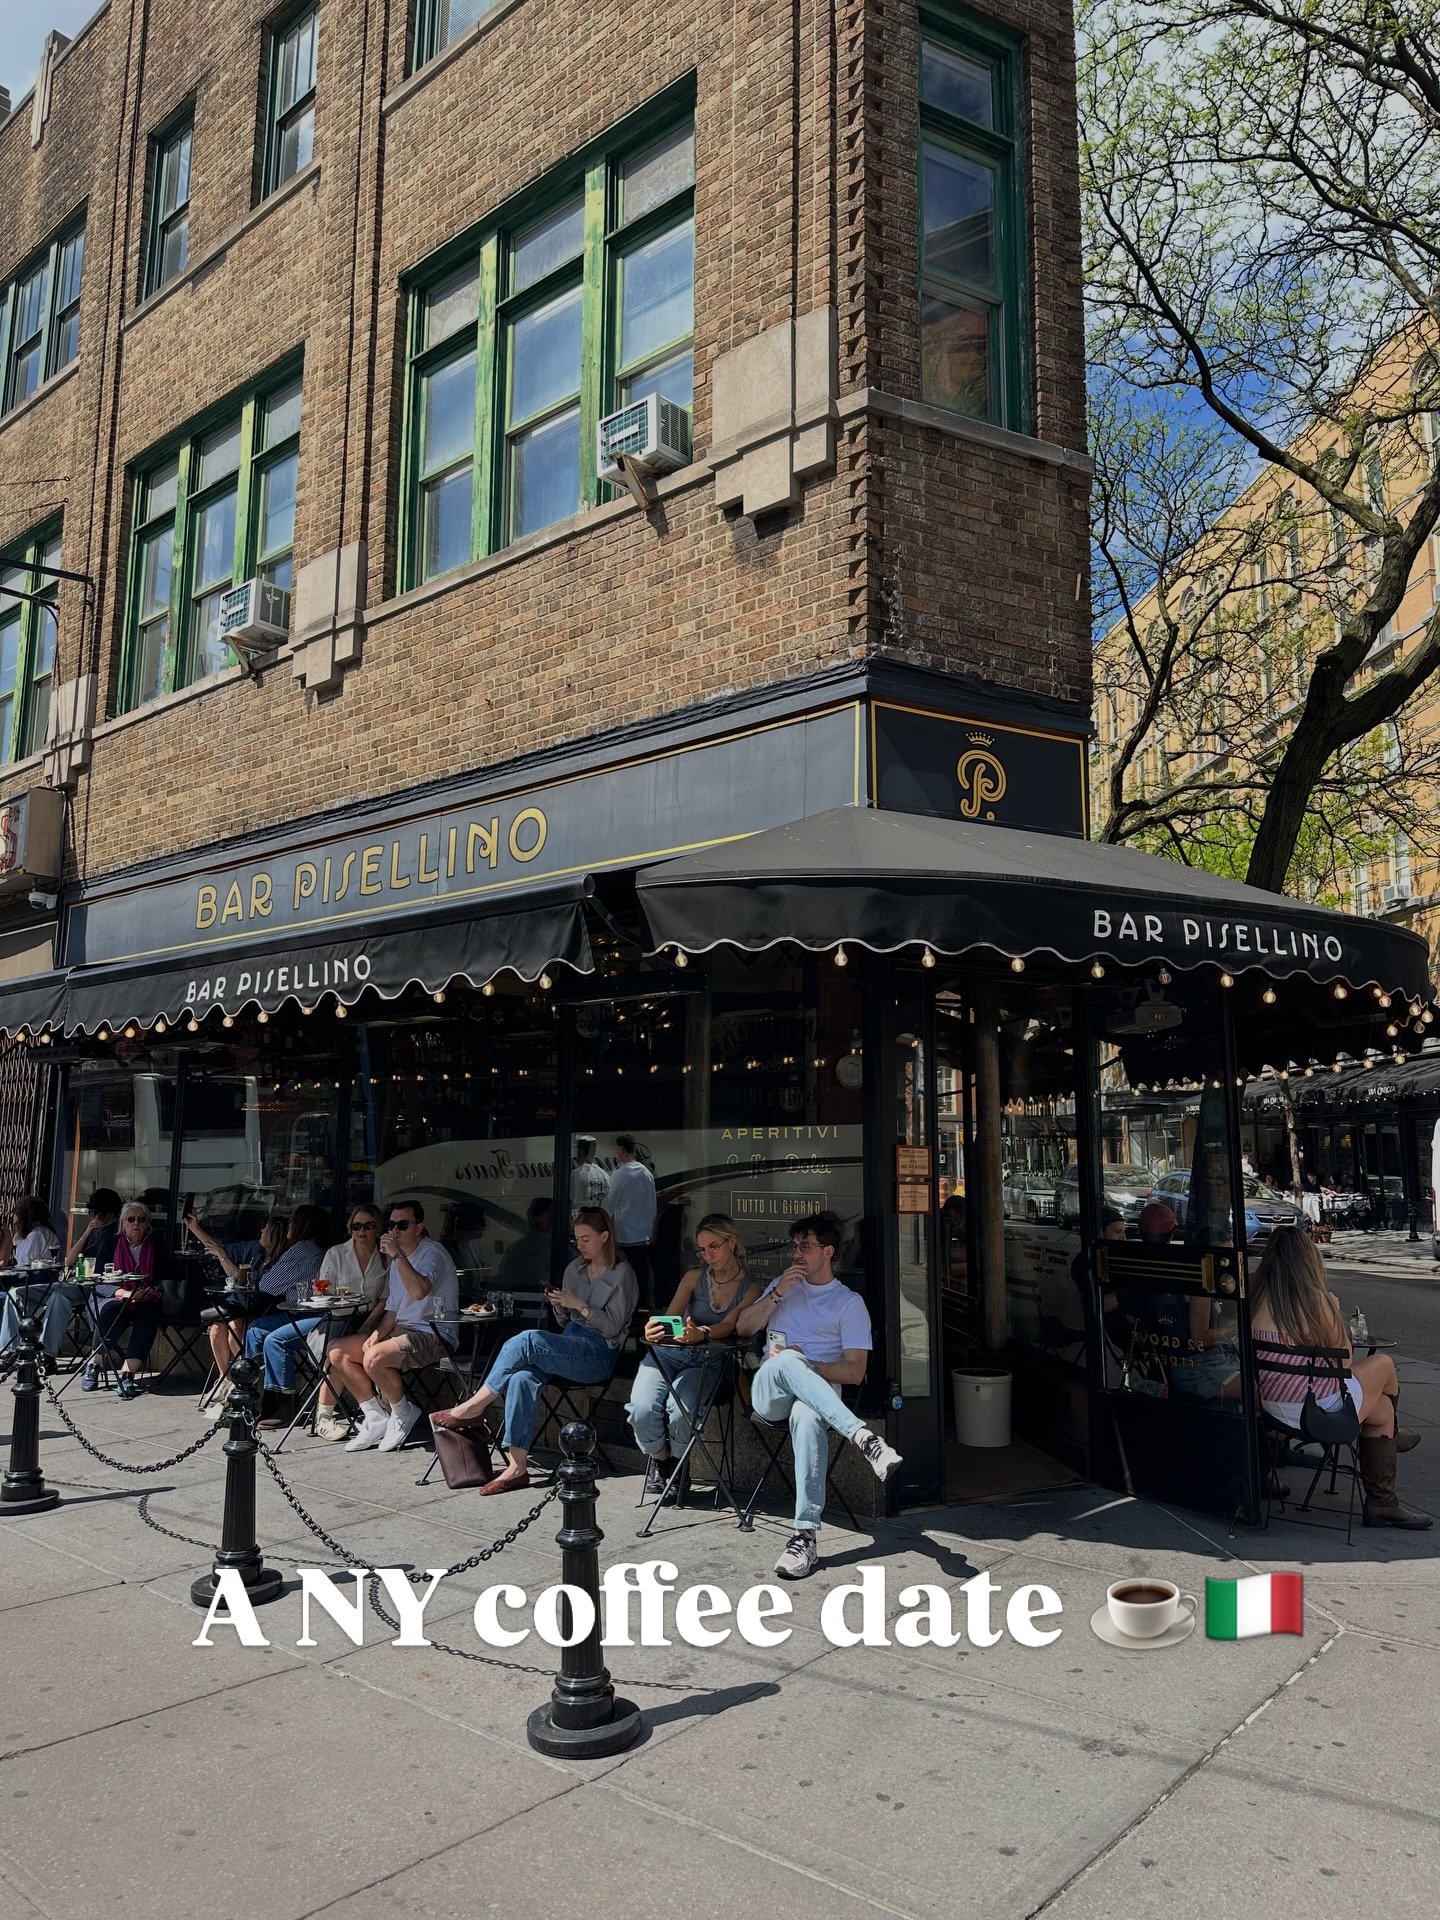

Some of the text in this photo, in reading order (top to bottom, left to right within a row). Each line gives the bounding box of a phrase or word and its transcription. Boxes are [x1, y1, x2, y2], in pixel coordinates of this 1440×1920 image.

[195, 806, 549, 930] BAR PISELLINO
[1093, 909, 1343, 963] BAR PISELLINO
[185, 954, 372, 1004] BAR PISELLINO
[721, 1126, 839, 1141] APERITIVI
[736, 1198, 821, 1215] TUTTO IL GIORNO
